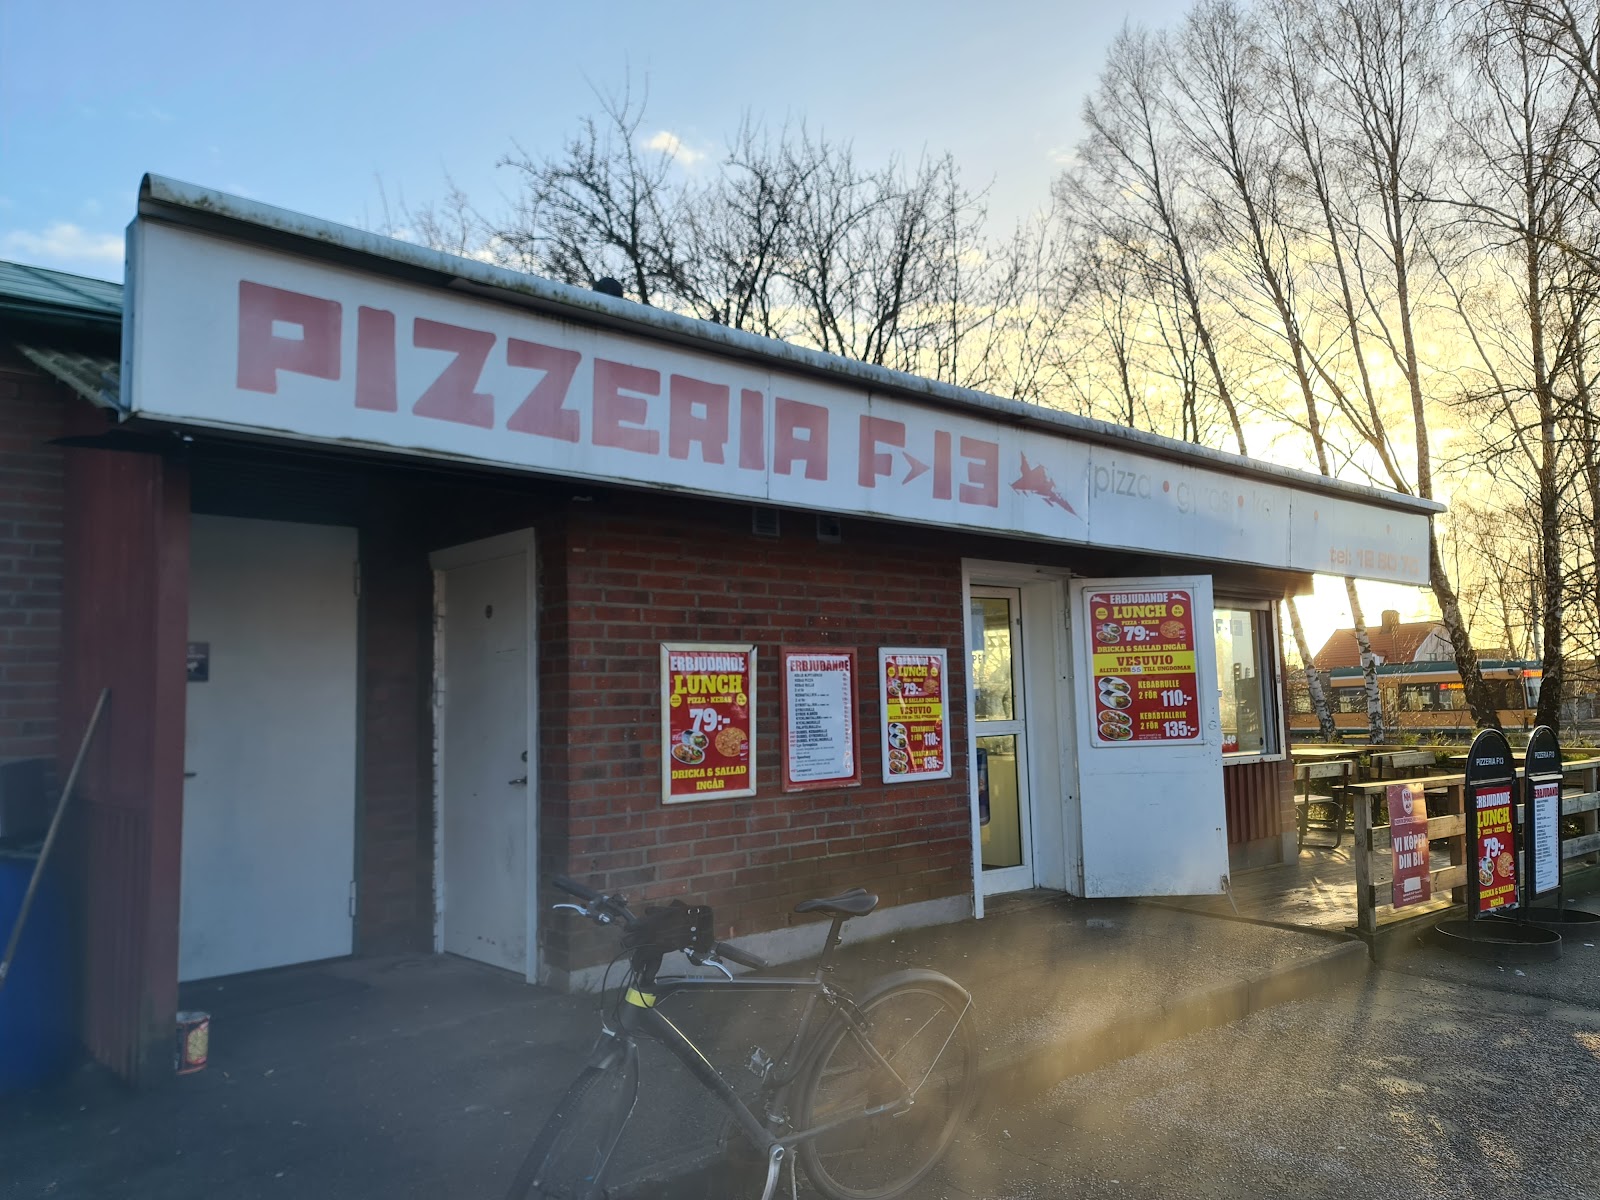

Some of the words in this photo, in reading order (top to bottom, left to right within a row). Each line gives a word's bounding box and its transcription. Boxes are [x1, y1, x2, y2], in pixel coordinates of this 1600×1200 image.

[236, 280, 829, 481] PIZZERIA
[1093, 461, 1152, 500] pizza
[1109, 593, 1169, 605] ERBJUDANDE
[1112, 604, 1167, 619] LUNCH
[1123, 625, 1159, 641] 79:-
[1097, 645, 1125, 653] DRICKA
[1133, 644, 1161, 652] SALLAD
[1163, 642, 1187, 651] INGÅR
[670, 656, 745, 672] ERBJUDANDE
[790, 660, 849, 672] ERBJUDANDE
[1116, 655, 1174, 667] VESUVIO
[898, 666, 928, 677] LUNCH
[674, 674, 743, 695] LUNCH
[1137, 680, 1180, 689] KEBABRULLE
[1138, 691, 1143, 699] 2
[1144, 690, 1158, 699] FÖR
[1160, 689, 1192, 707] 110:-
[689, 707, 731, 732] 79:-
[1140, 711, 1187, 720] KEBABTALLRIK
[1140, 722, 1145, 730] 2
[1146, 721, 1159, 730] FÖR
[1163, 721, 1197, 737] 135:-
[1475, 757, 1496, 766] PIZZERIA
[671, 768, 705, 780] DRICKA
[707, 767, 713, 777] &
[714, 765, 747, 777] SALLAD
[696, 778, 725, 791] INGÅR
[1477, 806, 1510, 828] LUNCH
[1394, 836, 1403, 853] VI
[1404, 831, 1427, 851] KÖPER
[1483, 836, 1504, 859] 79:-
[1398, 852, 1412, 870] DIN
[1412, 850, 1424, 867] BIL
